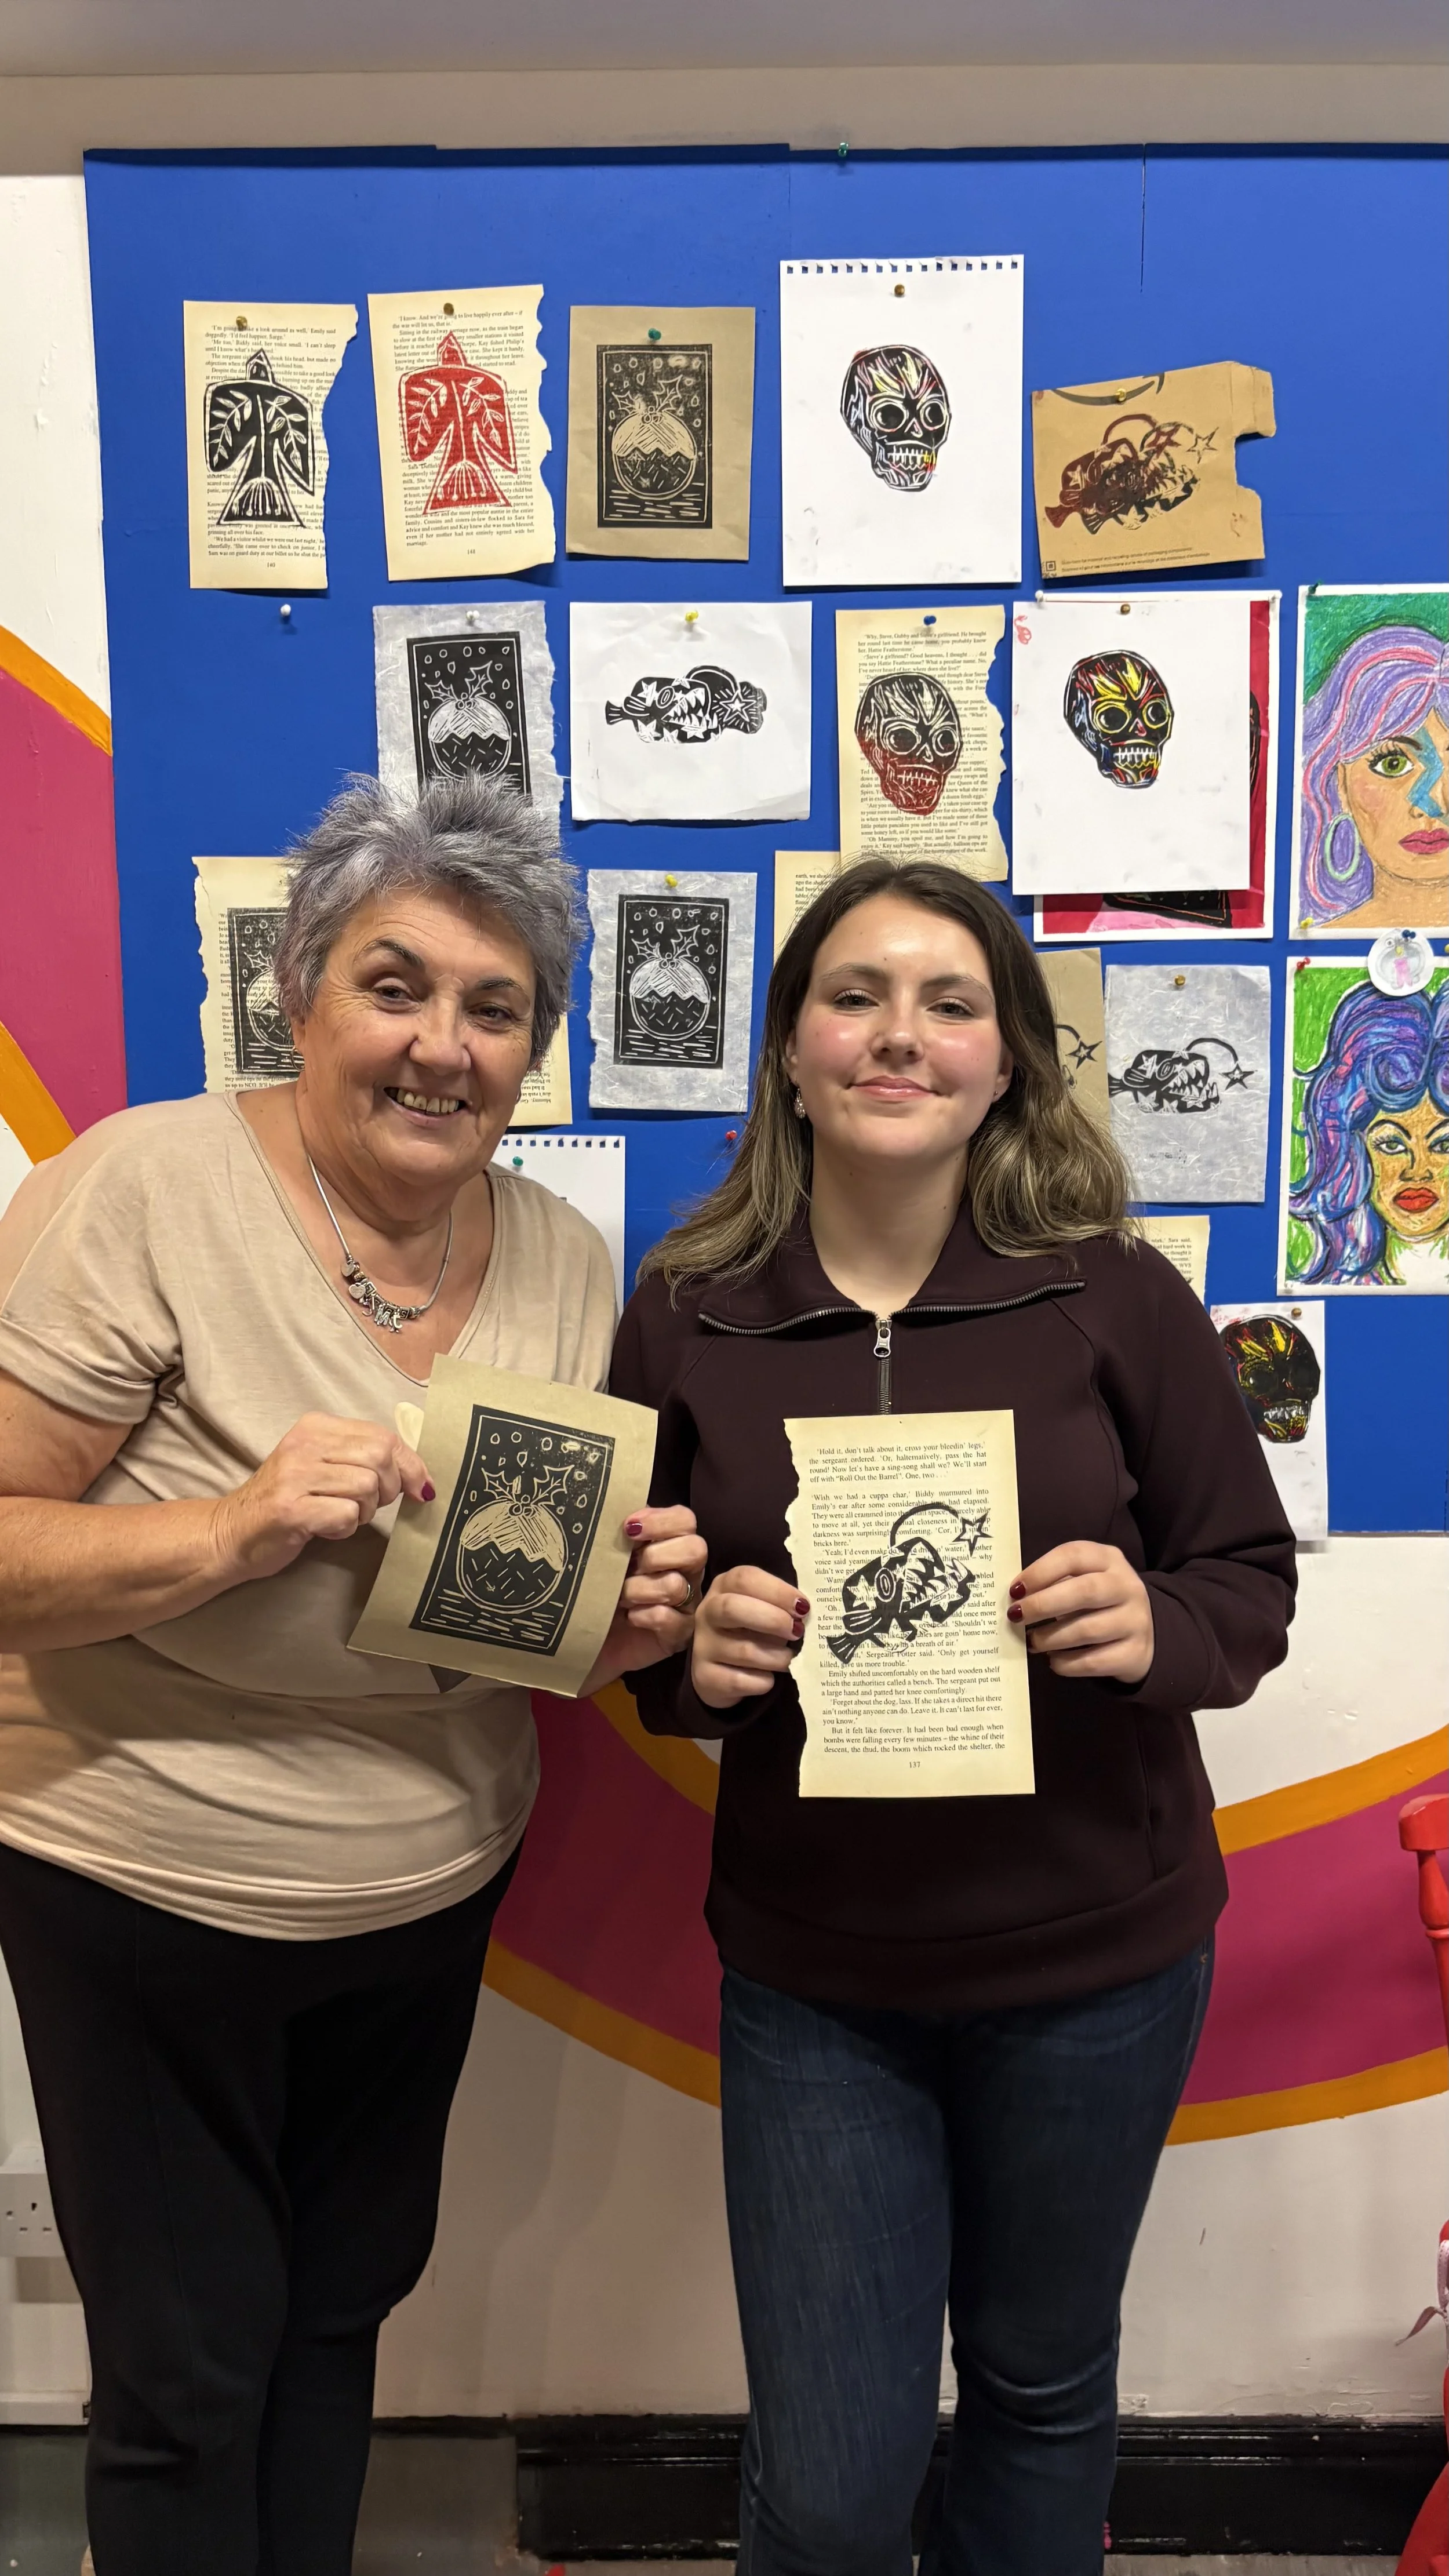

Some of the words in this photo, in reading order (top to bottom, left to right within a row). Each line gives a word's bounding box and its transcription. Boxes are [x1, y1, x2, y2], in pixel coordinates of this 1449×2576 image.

[822, 1457, 847, 1465] sergeant
[887, 1464, 918, 1472] sing-song
[828, 1670, 847, 1679] Emily
[872, 1669, 918, 1678] uncomfortably
[950, 1676, 976, 1685] sergeant
[978, 1676, 988, 1684] put
[827, 1689, 842, 1697] large
[873, 1688, 893, 1696] patted
[960, 1724, 984, 1733] enough
